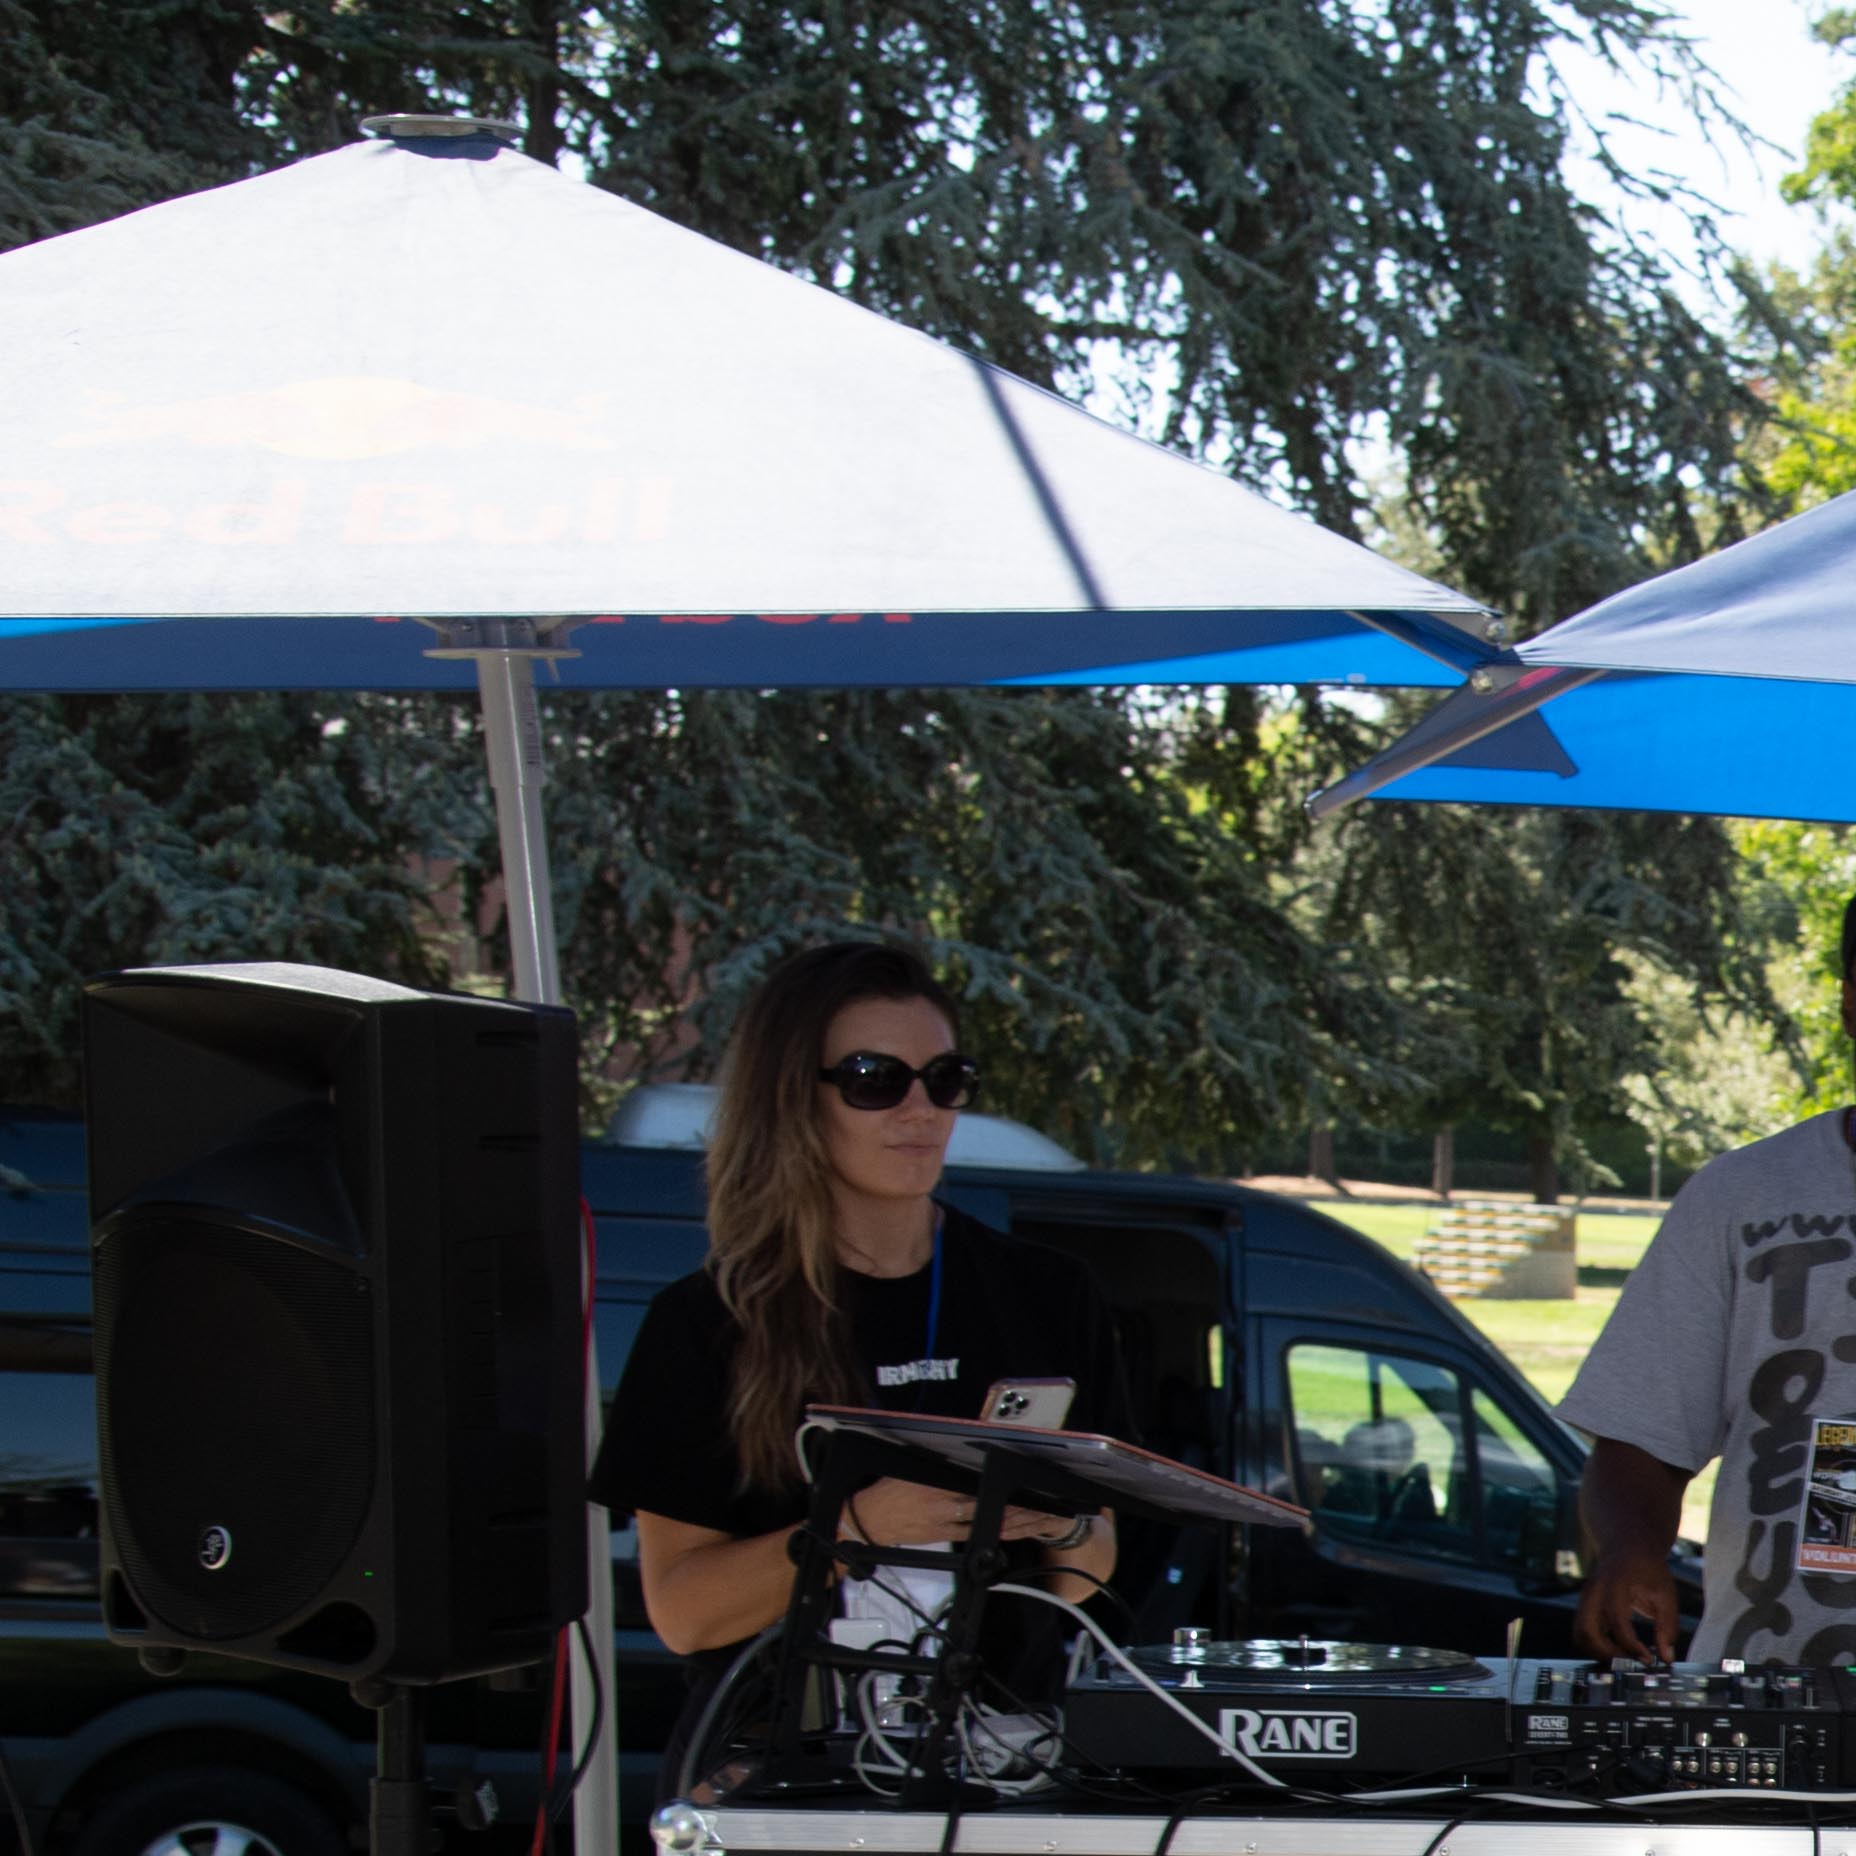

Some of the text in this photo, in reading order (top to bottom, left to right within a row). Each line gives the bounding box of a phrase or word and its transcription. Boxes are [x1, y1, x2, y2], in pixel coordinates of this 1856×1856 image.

[0, 475, 673, 546] Red Bull
[1218, 1708, 1351, 1757] RANE
[1527, 1715, 1569, 1731] RANE
